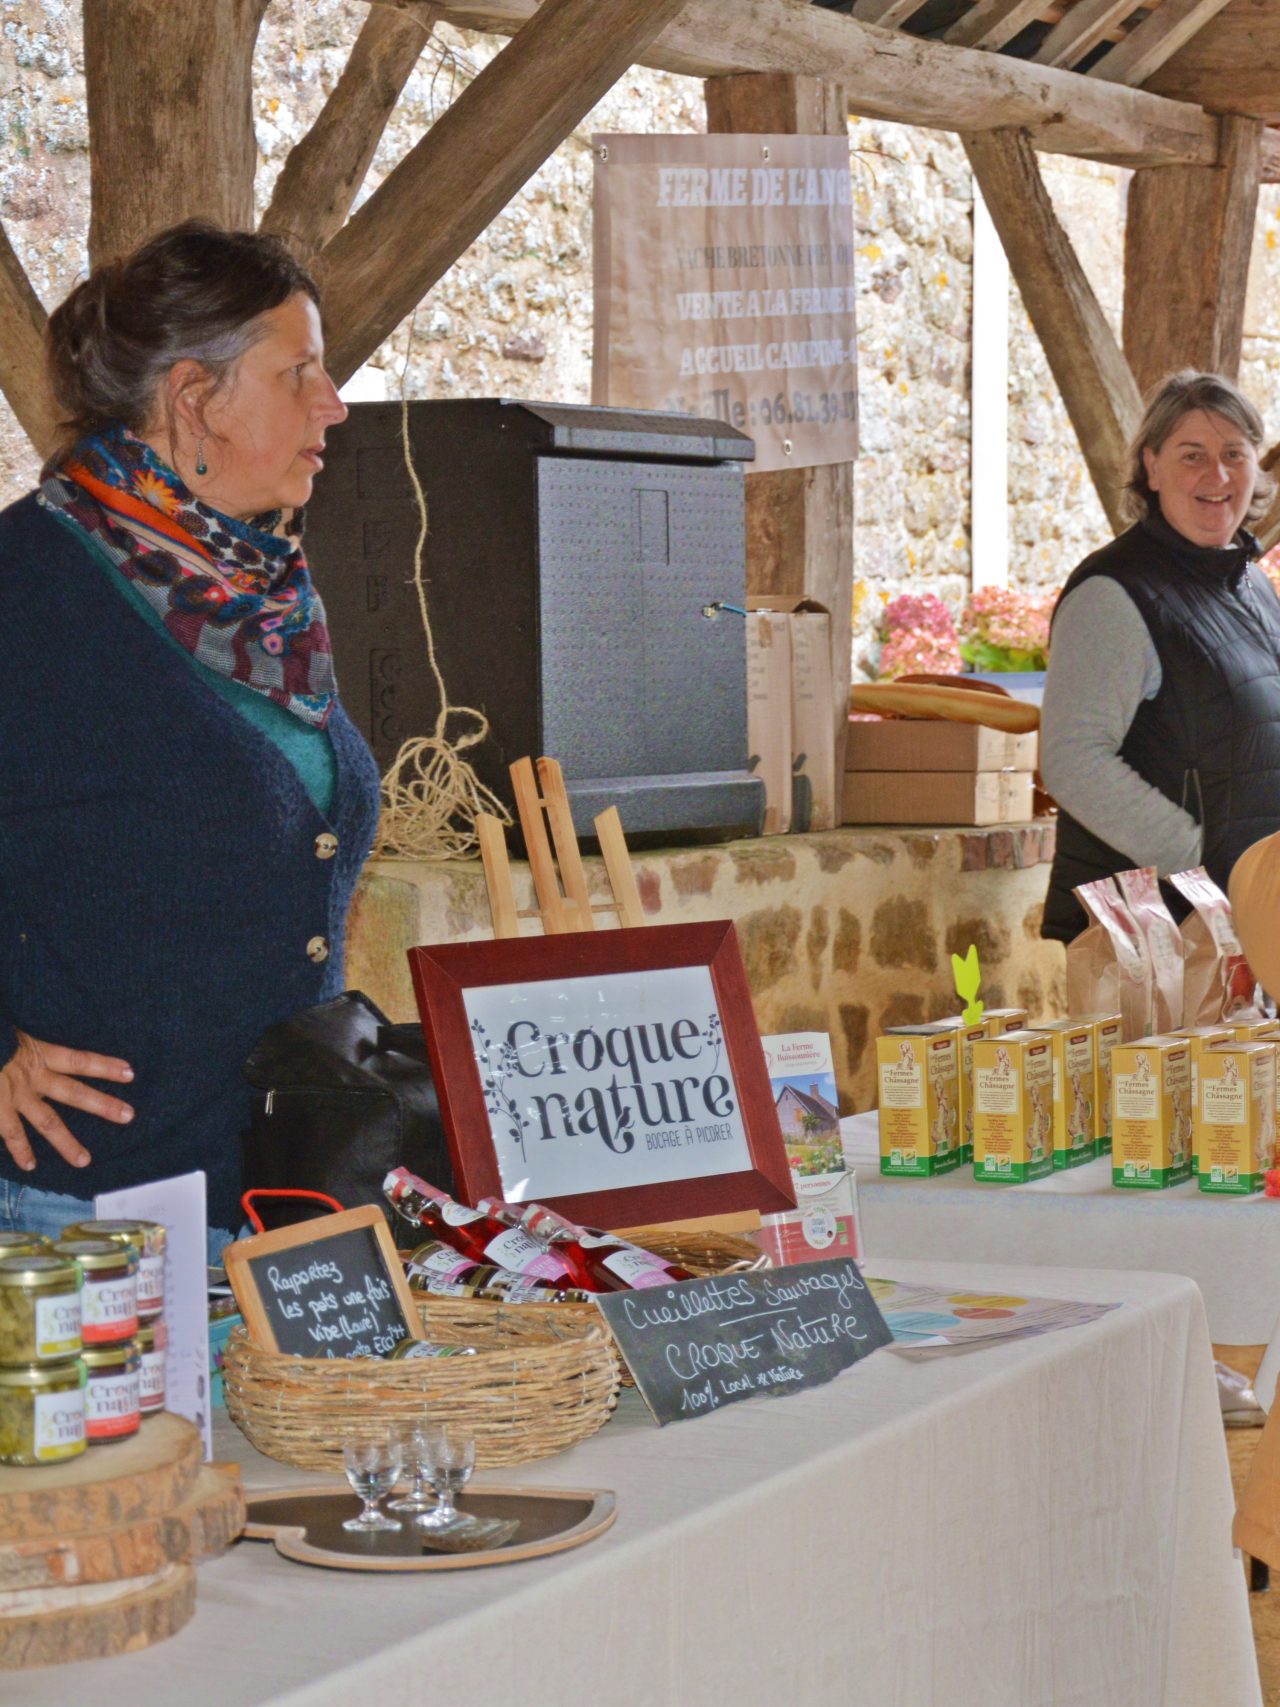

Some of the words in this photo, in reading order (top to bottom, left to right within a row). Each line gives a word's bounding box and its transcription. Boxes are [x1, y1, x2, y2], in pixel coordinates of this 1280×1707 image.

[656, 168, 748, 207] FERME
[751, 168, 785, 206] DE
[677, 290, 743, 321] VENTE
[747, 289, 761, 318] A
[763, 289, 788, 317] LA
[790, 286, 844, 315] FERME
[679, 343, 764, 376] ACCUEIL
[506, 1019, 702, 1084] Croque
[531, 1074, 734, 1154] nature
[645, 1129, 682, 1151] BOCAGE
[685, 1126, 694, 1144] À
[696, 1122, 734, 1144] PICORER
[308, 1291, 339, 1322] pots
[343, 1291, 366, 1306] une
[364, 1274, 390, 1311] fois
[765, 1265, 865, 1310] Sauvages
[681, 1379, 719, 1411] 100%
